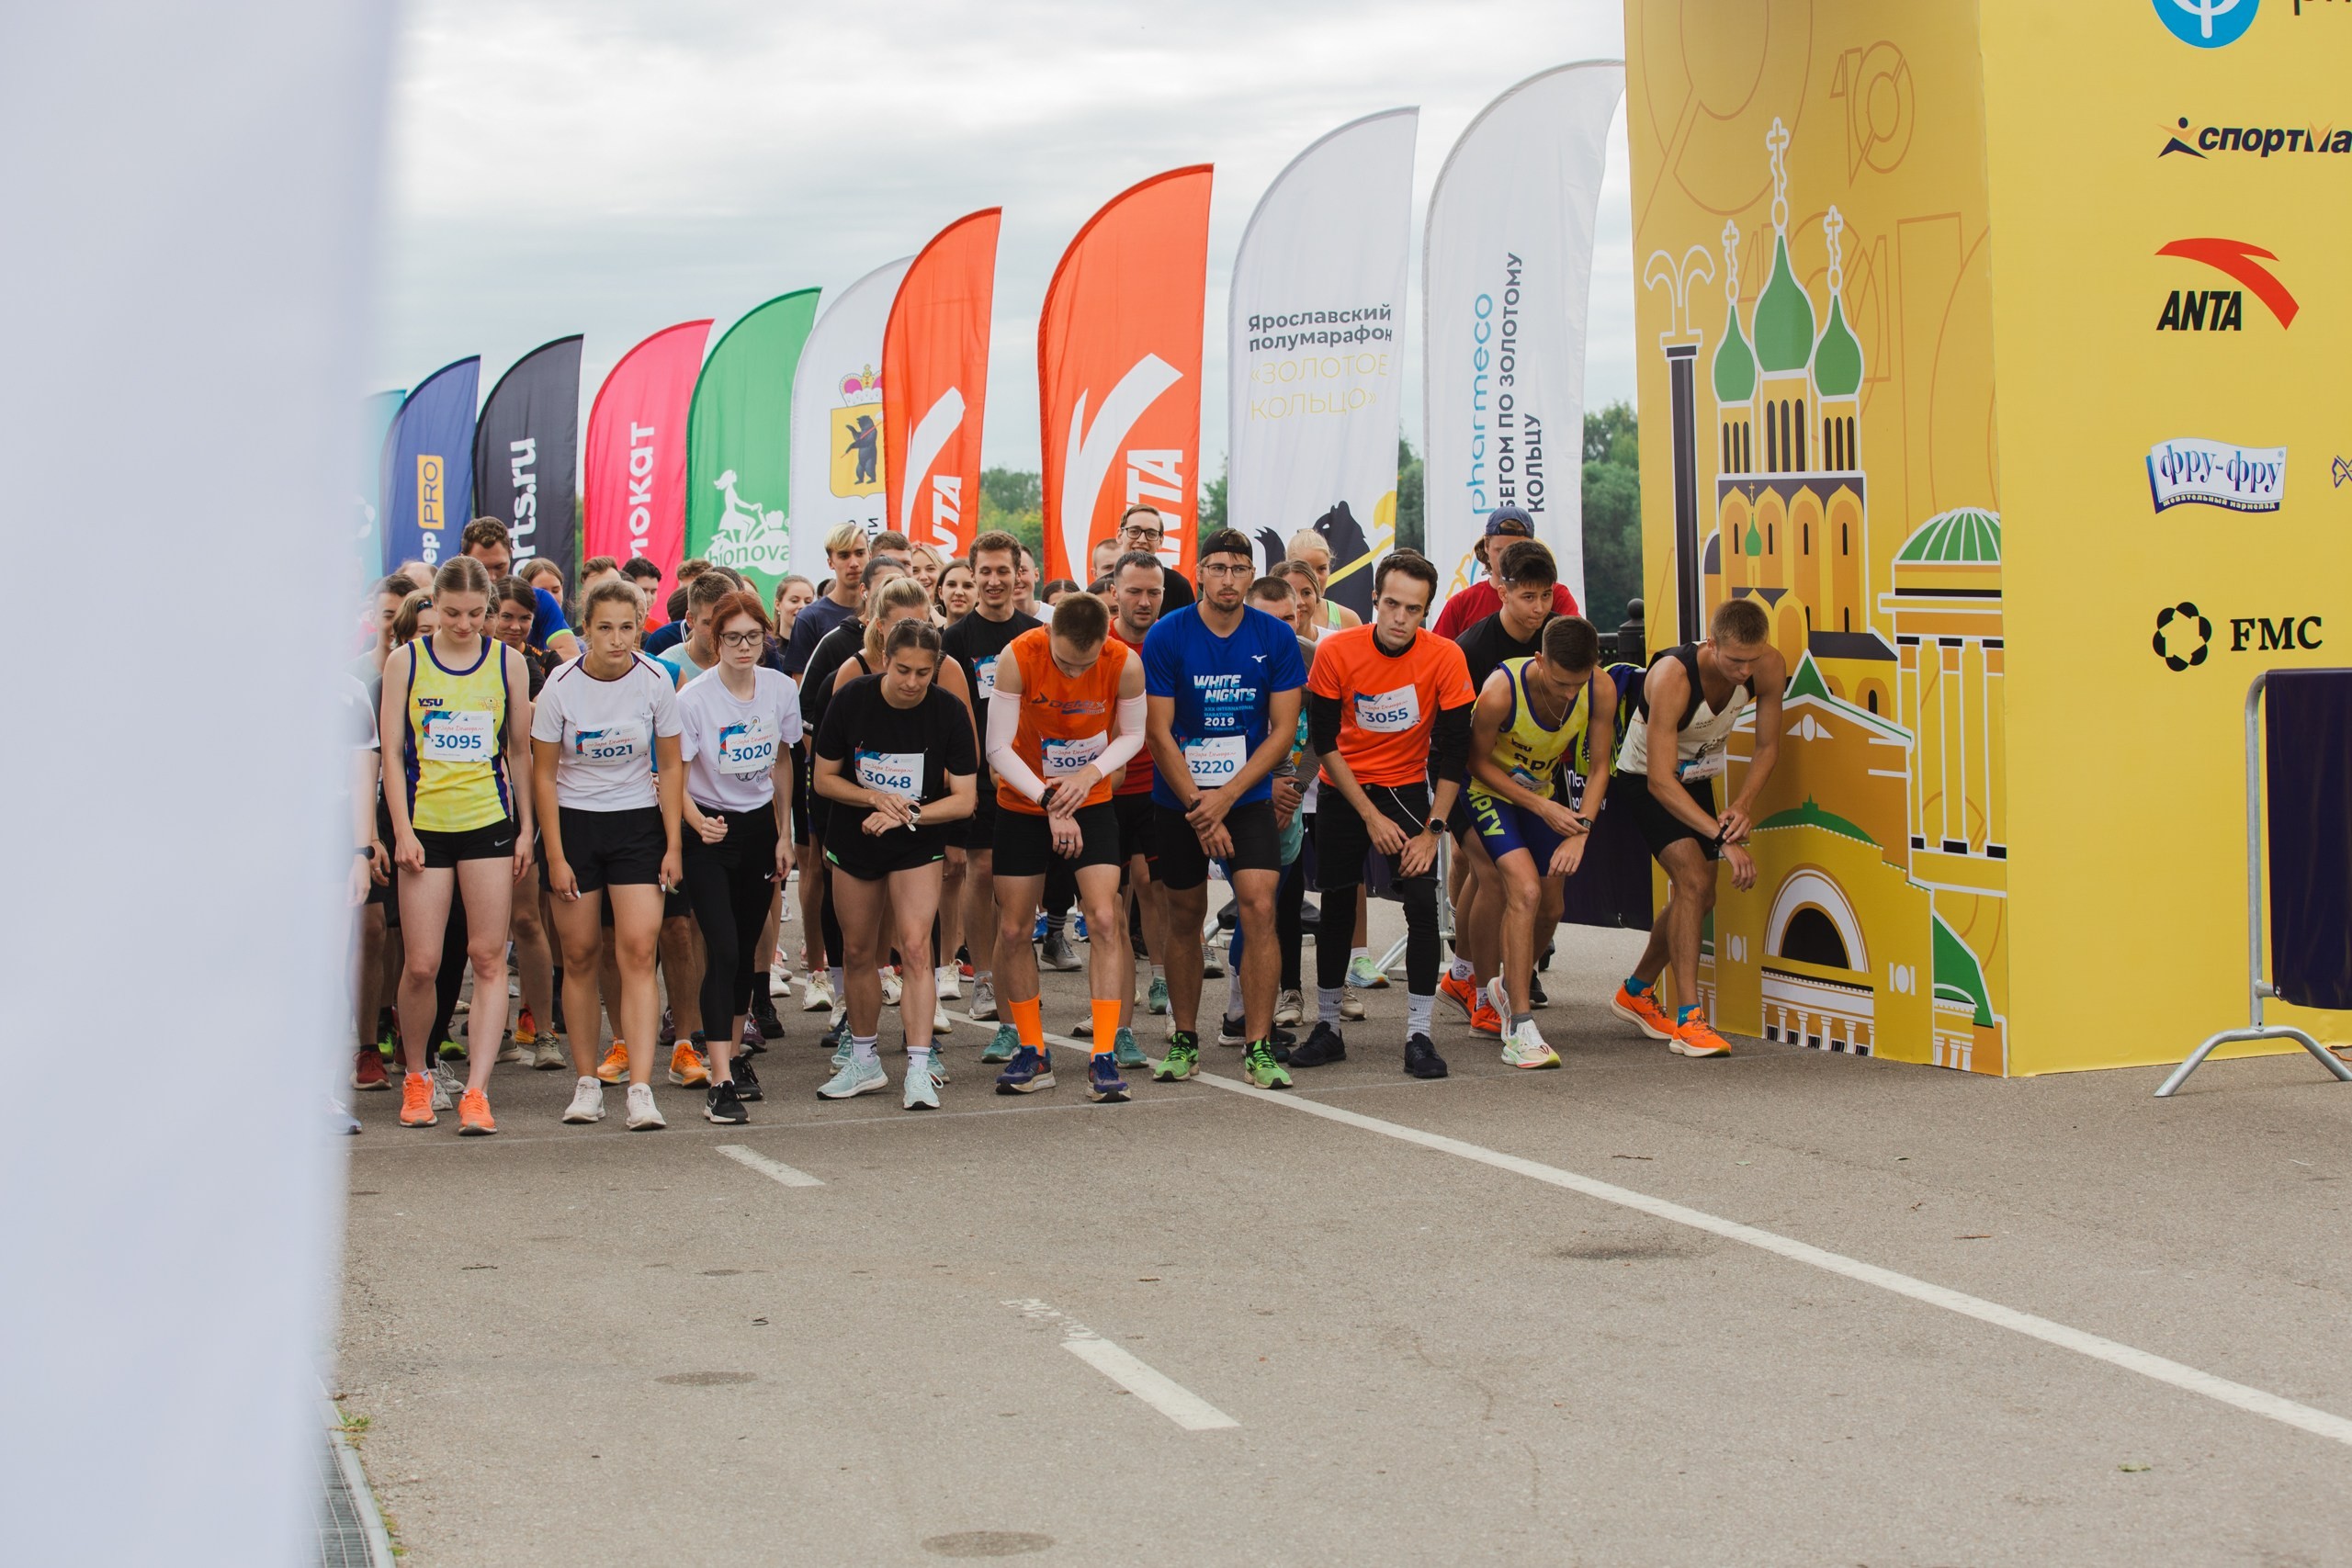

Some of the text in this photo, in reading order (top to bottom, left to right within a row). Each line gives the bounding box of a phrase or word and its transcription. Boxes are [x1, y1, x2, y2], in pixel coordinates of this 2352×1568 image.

[1248, 304, 1391, 333] Ярославский
[1498, 252, 1522, 387] ЗОЛОТОМУ
[2155, 290, 2242, 332] ANTA
[1250, 324, 1393, 352] полумарафон
[1466, 293, 1496, 514] pharmeco
[1498, 393, 1514, 428] ПО
[1524, 413, 1544, 513] КОЛЬЦУ
[424, 461, 439, 524] PRO
[932, 475, 962, 564] NTA
[1126, 449, 1183, 570] TA
[2230, 615, 2323, 651] FMC
[1193, 675, 1241, 689] WHITE
[418, 698, 443, 706] YSU
[1204, 688, 1257, 703] NIGHTS
[1204, 716, 1235, 727] 2019
[1364, 707, 1408, 723] 3055
[435, 734, 481, 749] 3095
[592, 744, 633, 759] 3021
[731, 742, 772, 761] 3020
[1053, 752, 1099, 768] 3054
[1191, 760, 1234, 773] 3220
[865, 769, 911, 789] 3048
